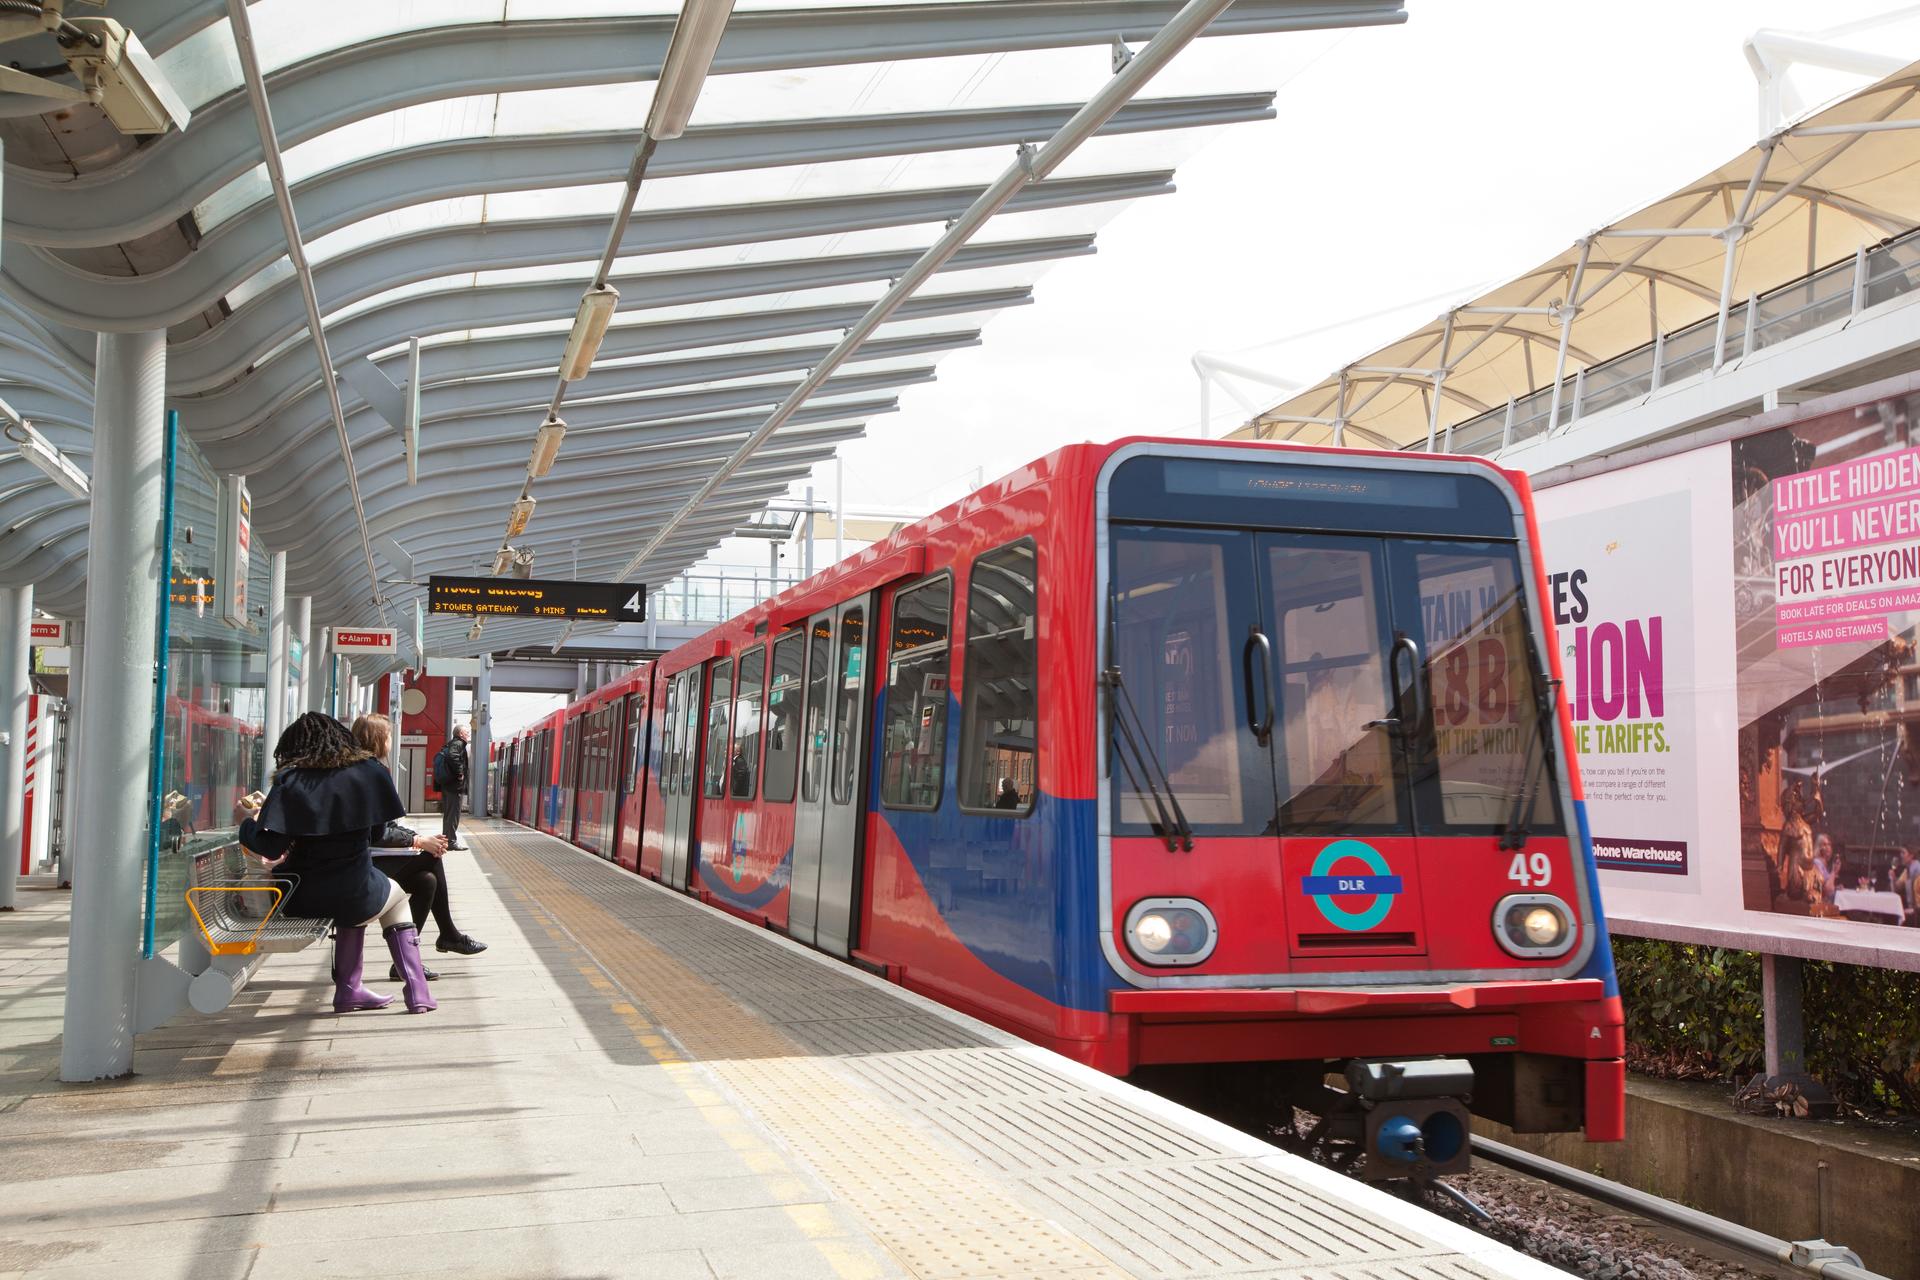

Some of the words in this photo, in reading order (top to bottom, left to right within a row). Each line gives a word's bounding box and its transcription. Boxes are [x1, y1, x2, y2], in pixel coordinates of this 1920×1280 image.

[1777, 470, 1841, 512] LITTLE
[1848, 453, 1920, 498] HIDDEN
[1777, 514, 1845, 554] YOU'LL
[1852, 499, 1920, 541] NEVER
[1779, 563, 1814, 596] FOR
[1822, 546, 1920, 590] EVERYON
[442, 603, 473, 611] TOWER
[476, 604, 519, 613] GATEWAY
[534, 606, 540, 614] 9
[623, 590, 641, 613] 4
[1547, 569, 1589, 625] ES
[1780, 608, 1802, 620] BOOK
[1804, 605, 1825, 617] LATE
[1826, 602, 1844, 614] FOR
[1846, 598, 1877, 611] DEALS
[1879, 596, 1893, 607] ON
[348, 635, 371, 643] Alarm
[1781, 630, 1814, 643] HOTELS
[1815, 628, 1834, 641] AND
[1835, 623, 1884, 638] GETAWAYS
[1557, 616, 1664, 721] ION
[1454, 729, 1478, 755] THE
[1595, 722, 1670, 754] TARIFFS.
[1617, 767, 1625, 775] tell
[1656, 767, 1666, 775] the
[1593, 791, 1603, 800] find
[1604, 791, 1612, 799] the
[1614, 792, 1632, 802] perfect
[1647, 792, 1655, 800] for
[1596, 781, 1616, 789] compare
[1622, 781, 1637, 790] range
[1644, 780, 1666, 788] different
[1621, 847, 1683, 862] Warehouse
[1508, 852, 1552, 887] 49
[1339, 879, 1366, 891] DLR
[1590, 1026, 1602, 1039] A
